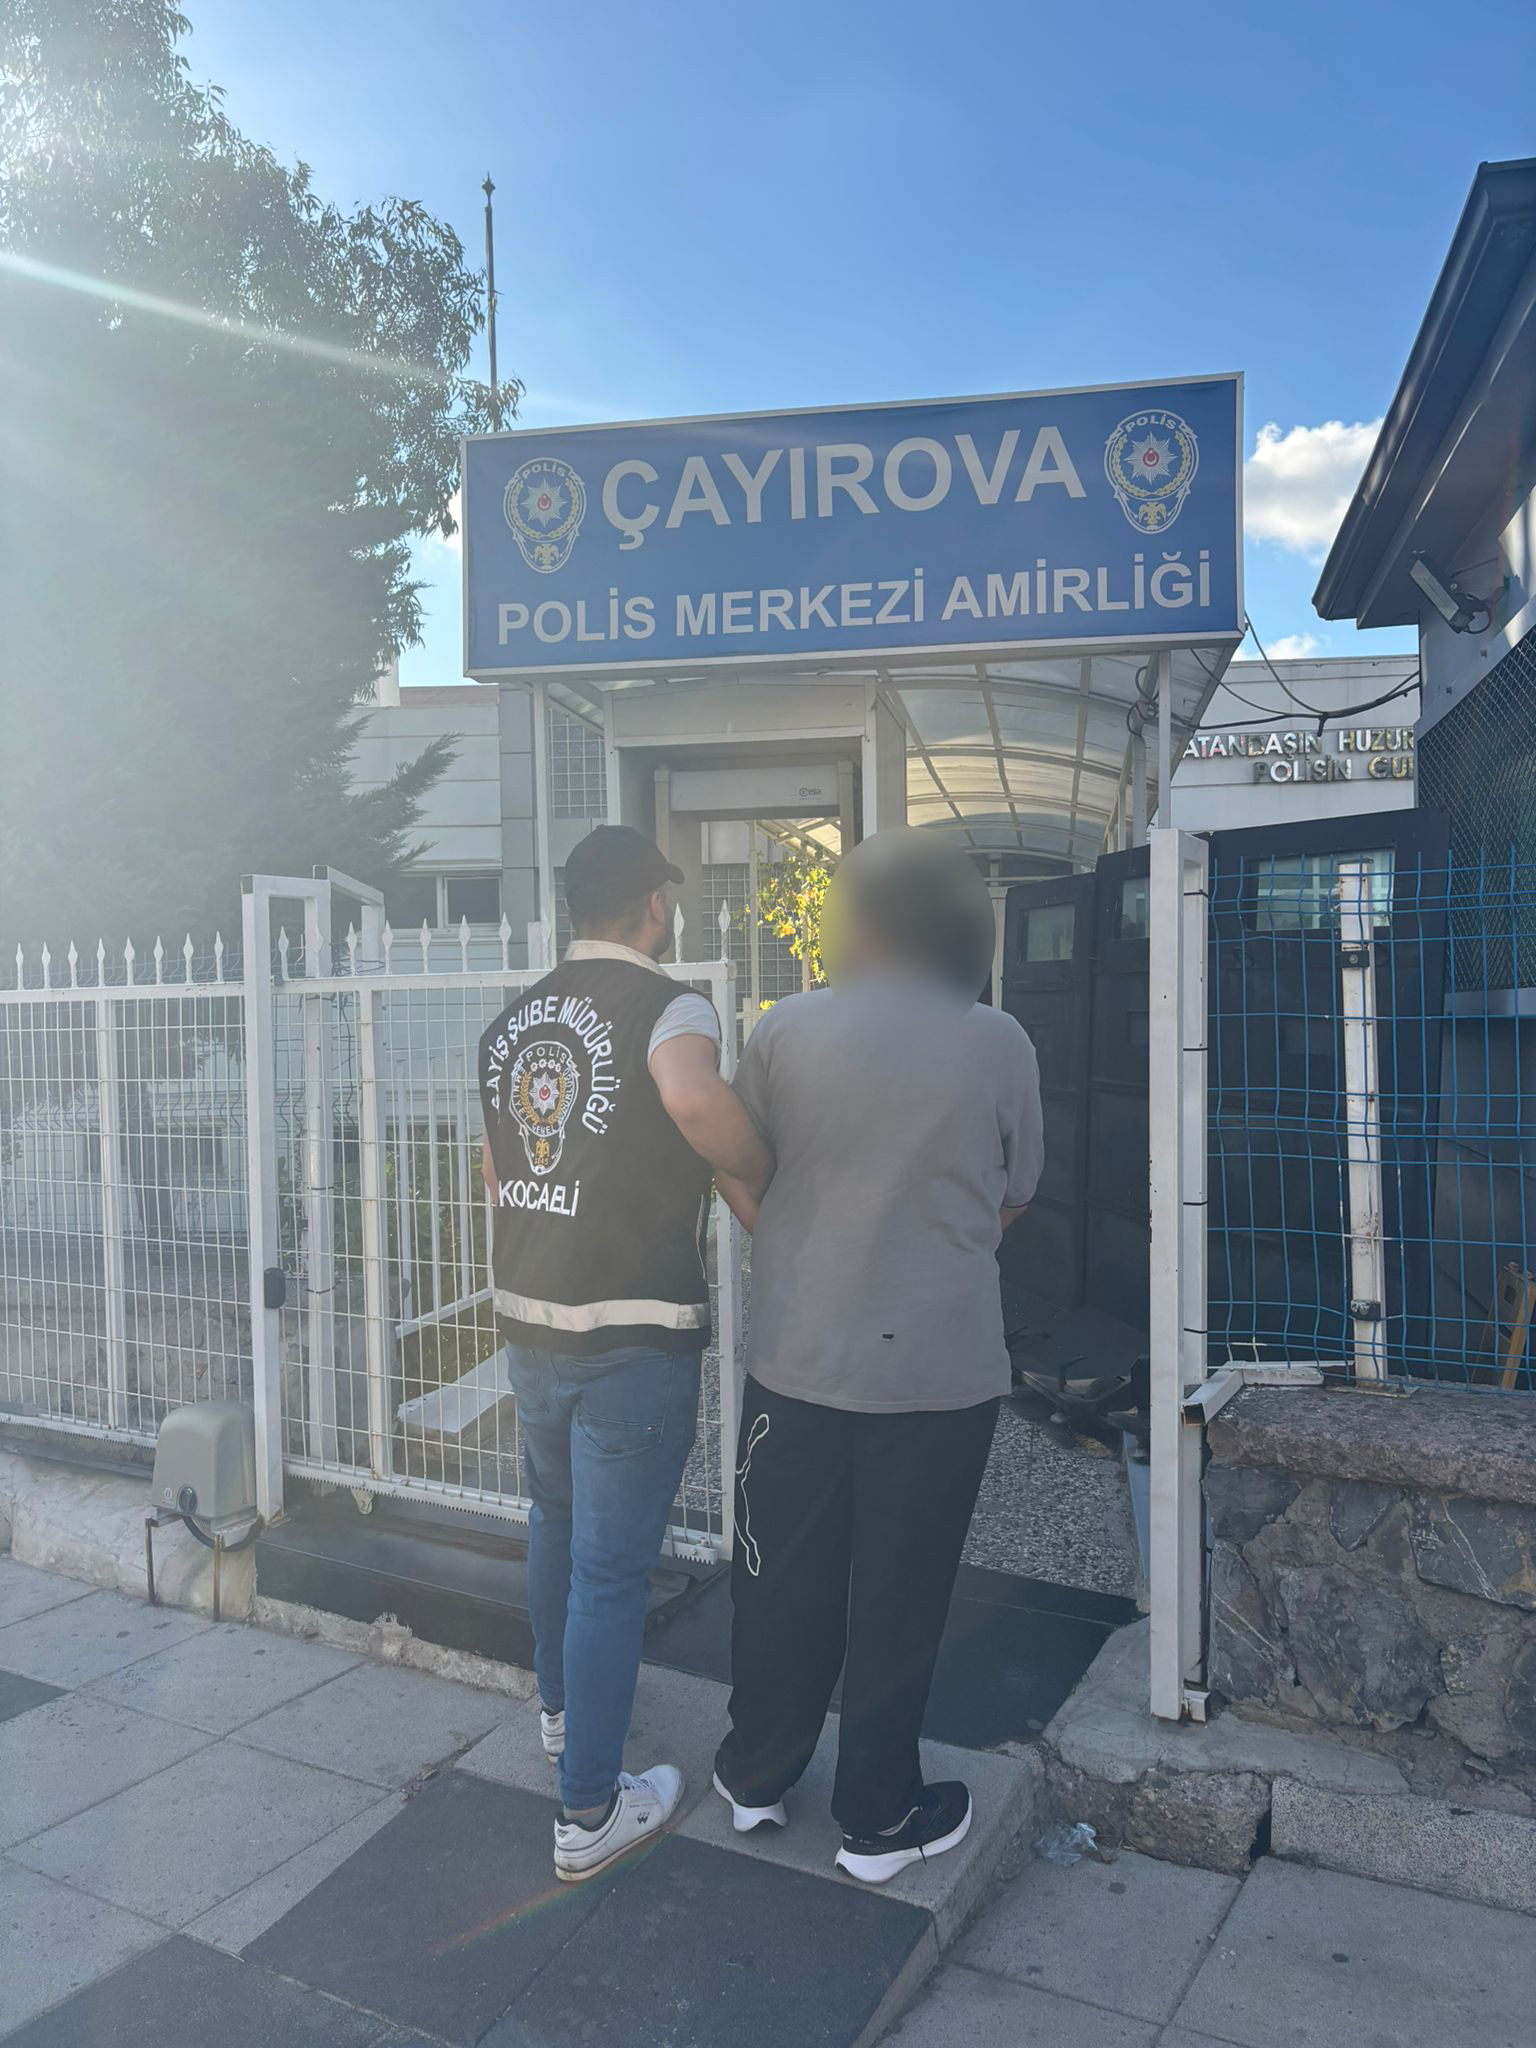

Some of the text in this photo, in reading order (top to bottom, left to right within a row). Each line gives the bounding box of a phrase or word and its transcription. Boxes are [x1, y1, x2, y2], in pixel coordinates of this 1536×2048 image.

[1125, 414, 1177, 432] POLİS
[522, 462, 566, 479] POLİS
[602, 426, 1087, 550] ÇAYIROVA
[498, 549, 1211, 645] POLİS MERKEZİ AMİRLİĞİ
[508, 996, 559, 1046] ŞUBE
[557, 996, 621, 1135] MÜDÜRLÜĞÜ
[526, 1046, 567, 1063] POLİS
[498, 1180, 580, 1217] KOCAELİ
